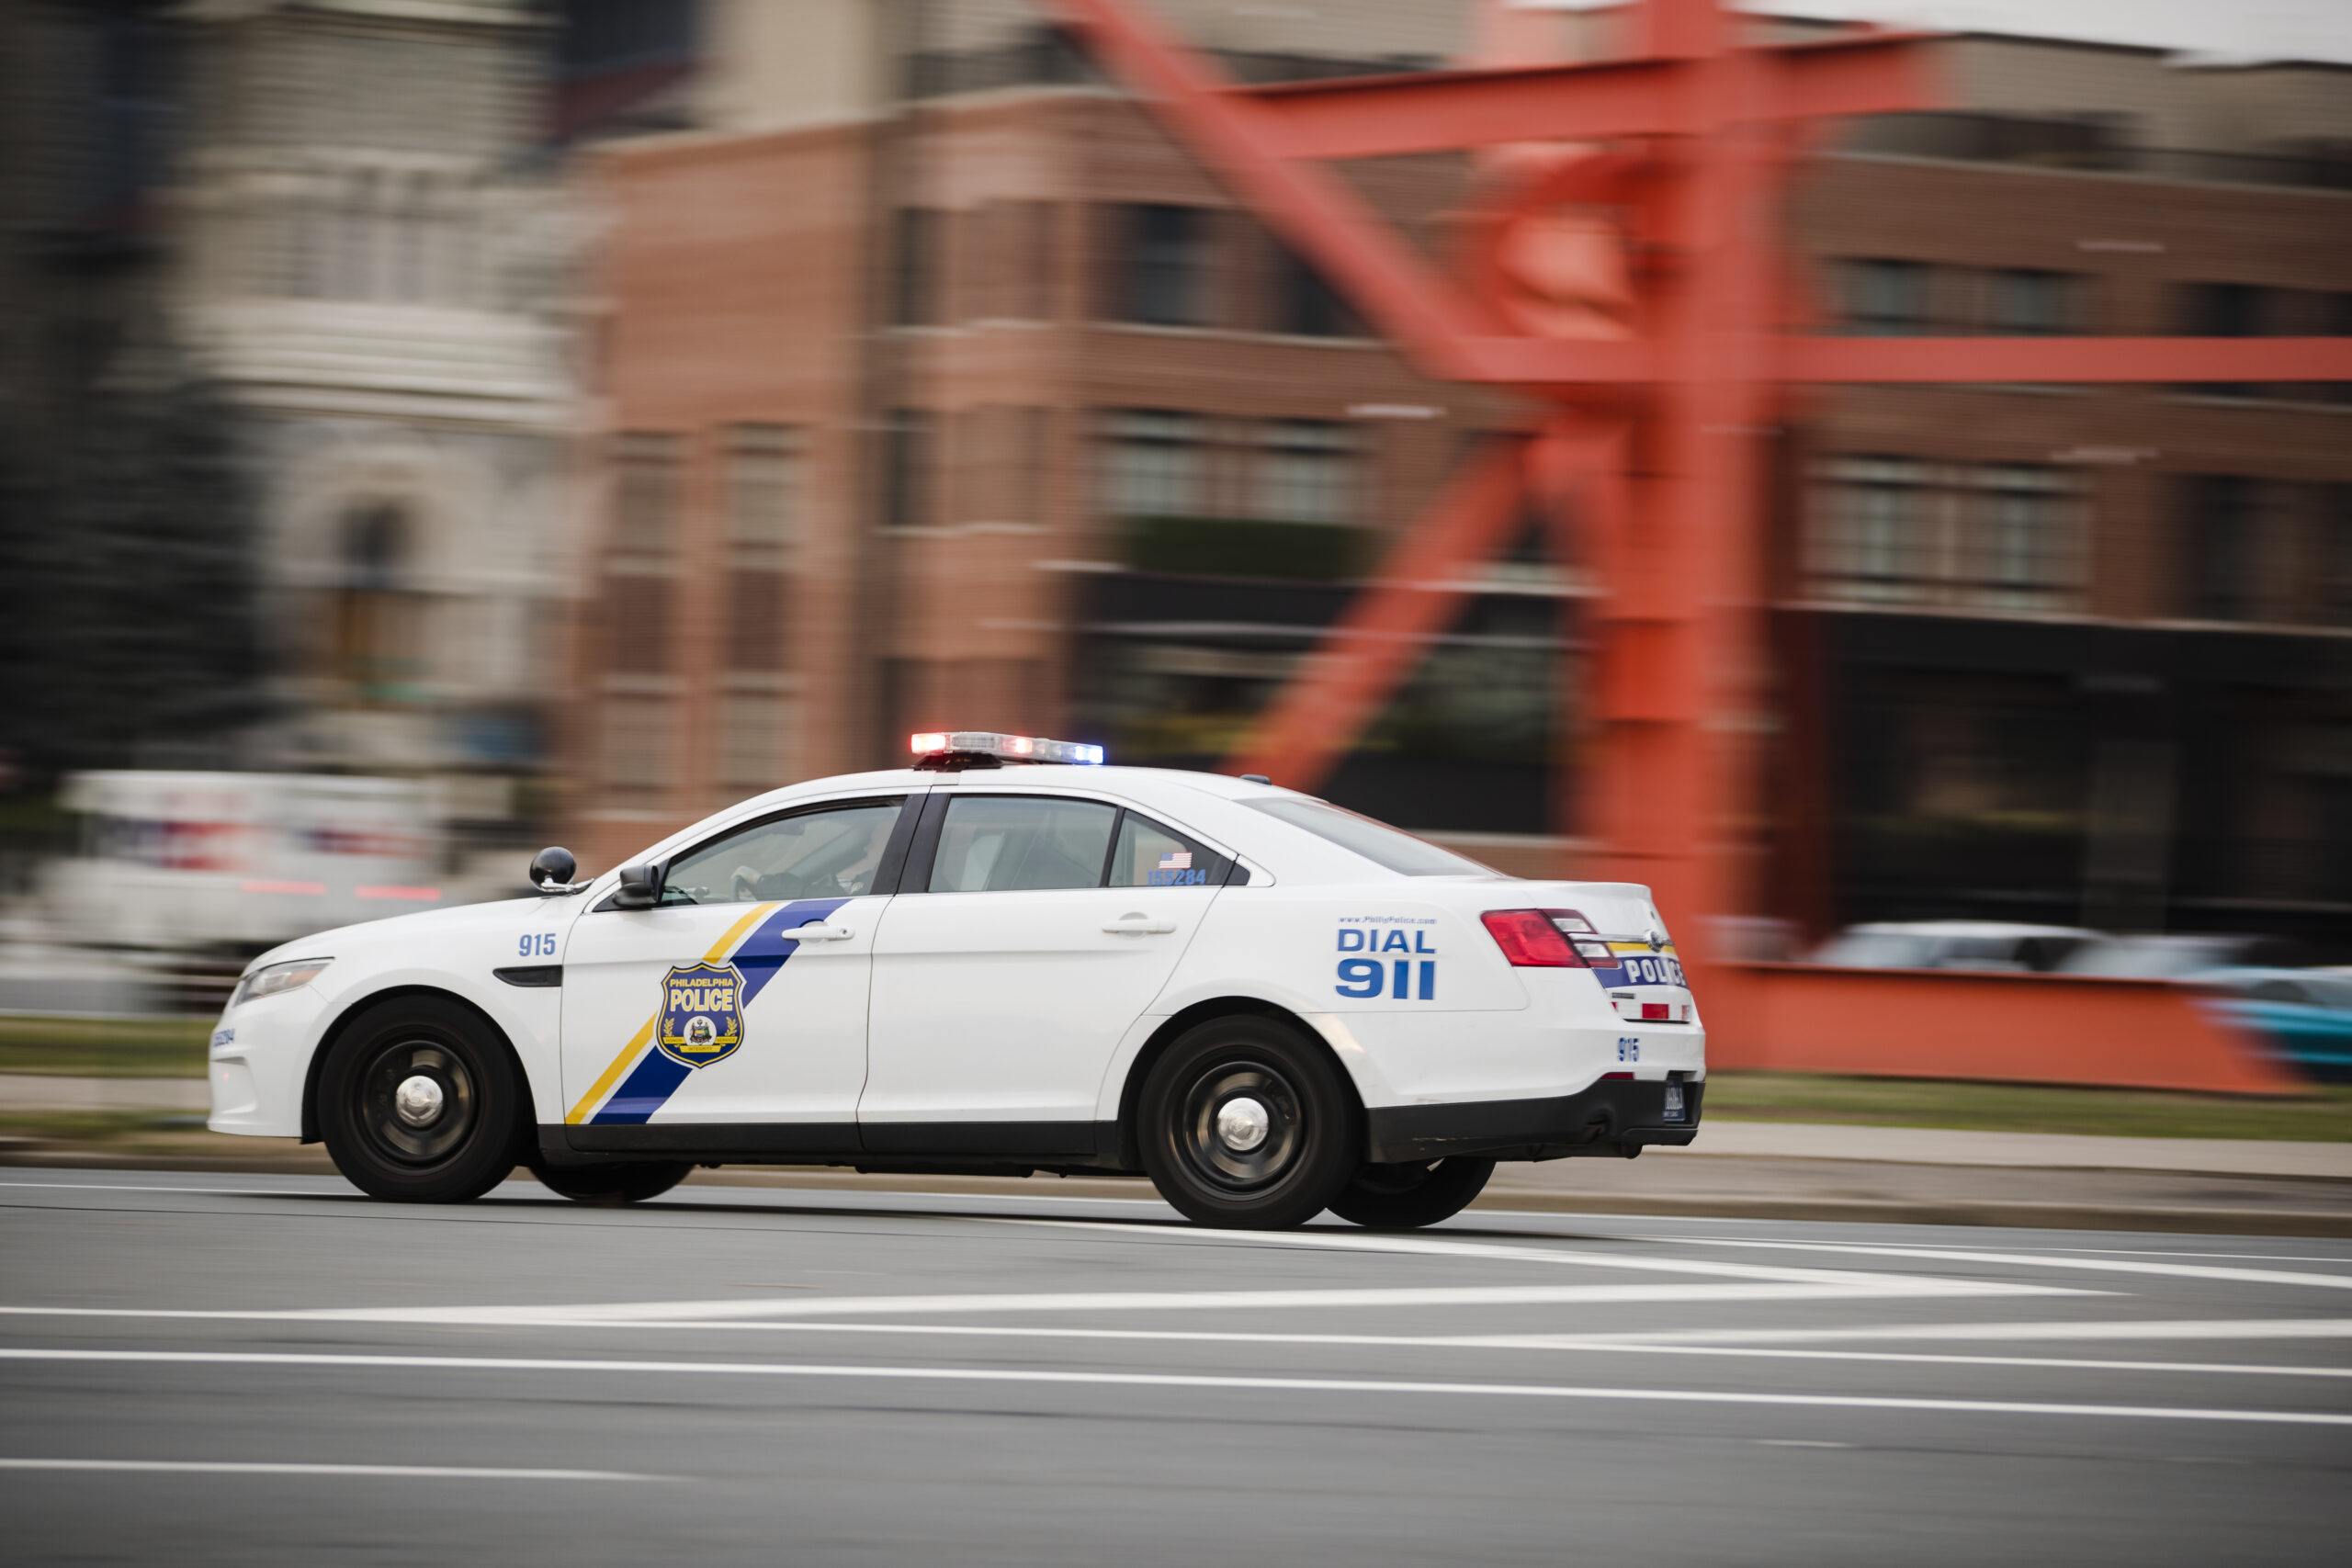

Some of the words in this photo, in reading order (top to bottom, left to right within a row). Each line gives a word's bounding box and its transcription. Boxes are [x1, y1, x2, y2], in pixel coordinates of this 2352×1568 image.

[1147, 869, 1206, 886] 155284
[518, 933, 556, 957] 915
[1337, 929, 1436, 954] DIAL
[670, 978, 734, 987] PHILADELPHIA
[1335, 958, 1435, 1000] 911
[1624, 958, 1688, 987] POLICE
[670, 988, 734, 1012] POLICE
[1618, 1037, 1640, 1062] 915
